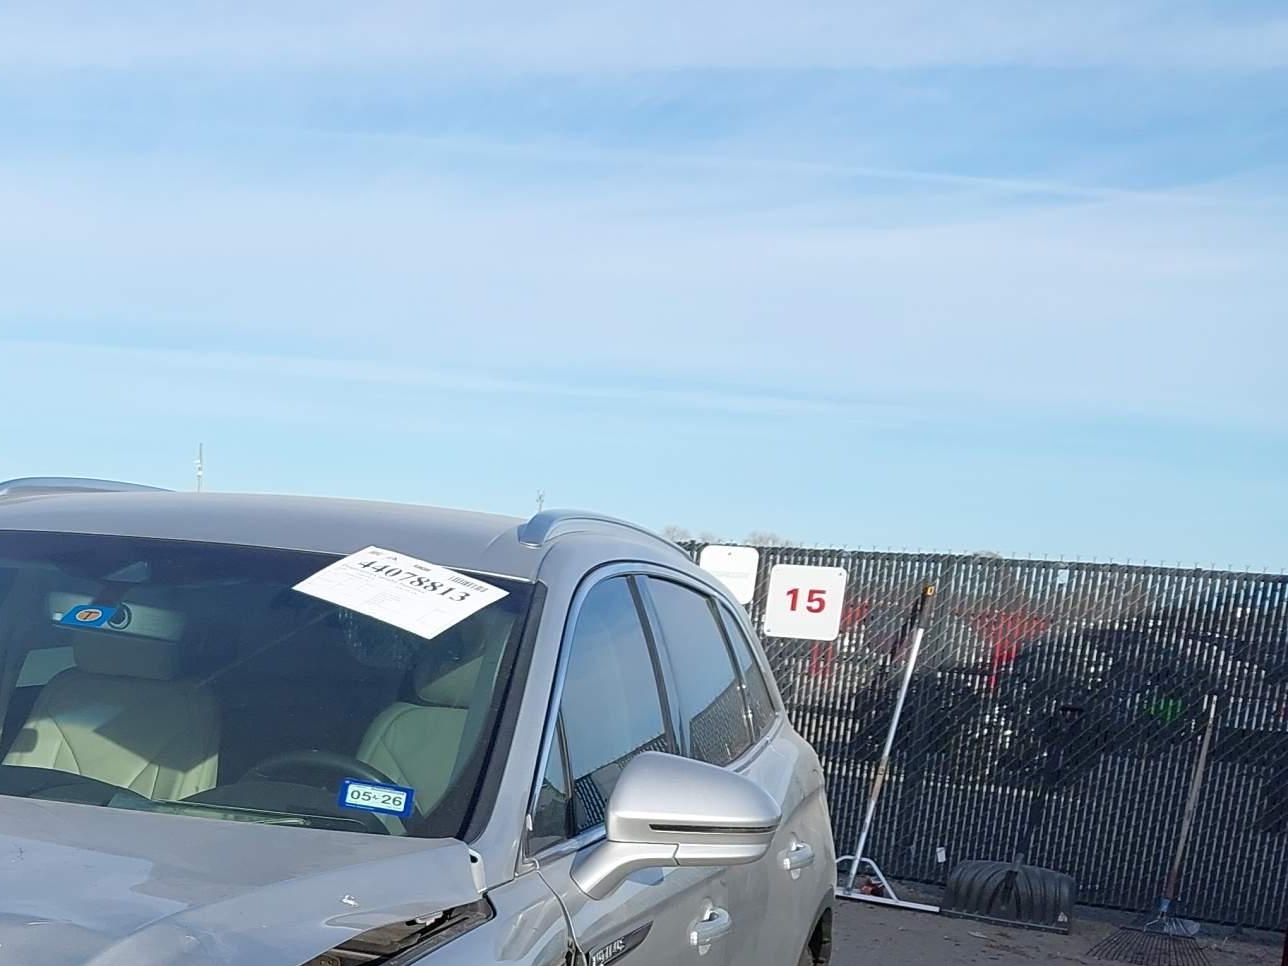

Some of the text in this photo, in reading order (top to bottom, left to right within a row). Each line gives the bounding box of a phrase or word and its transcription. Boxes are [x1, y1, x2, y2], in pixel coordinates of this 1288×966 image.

[358, 561, 470, 601] 44078813
[786, 588, 826, 613] 15
[351, 790, 402, 806] 05 26
